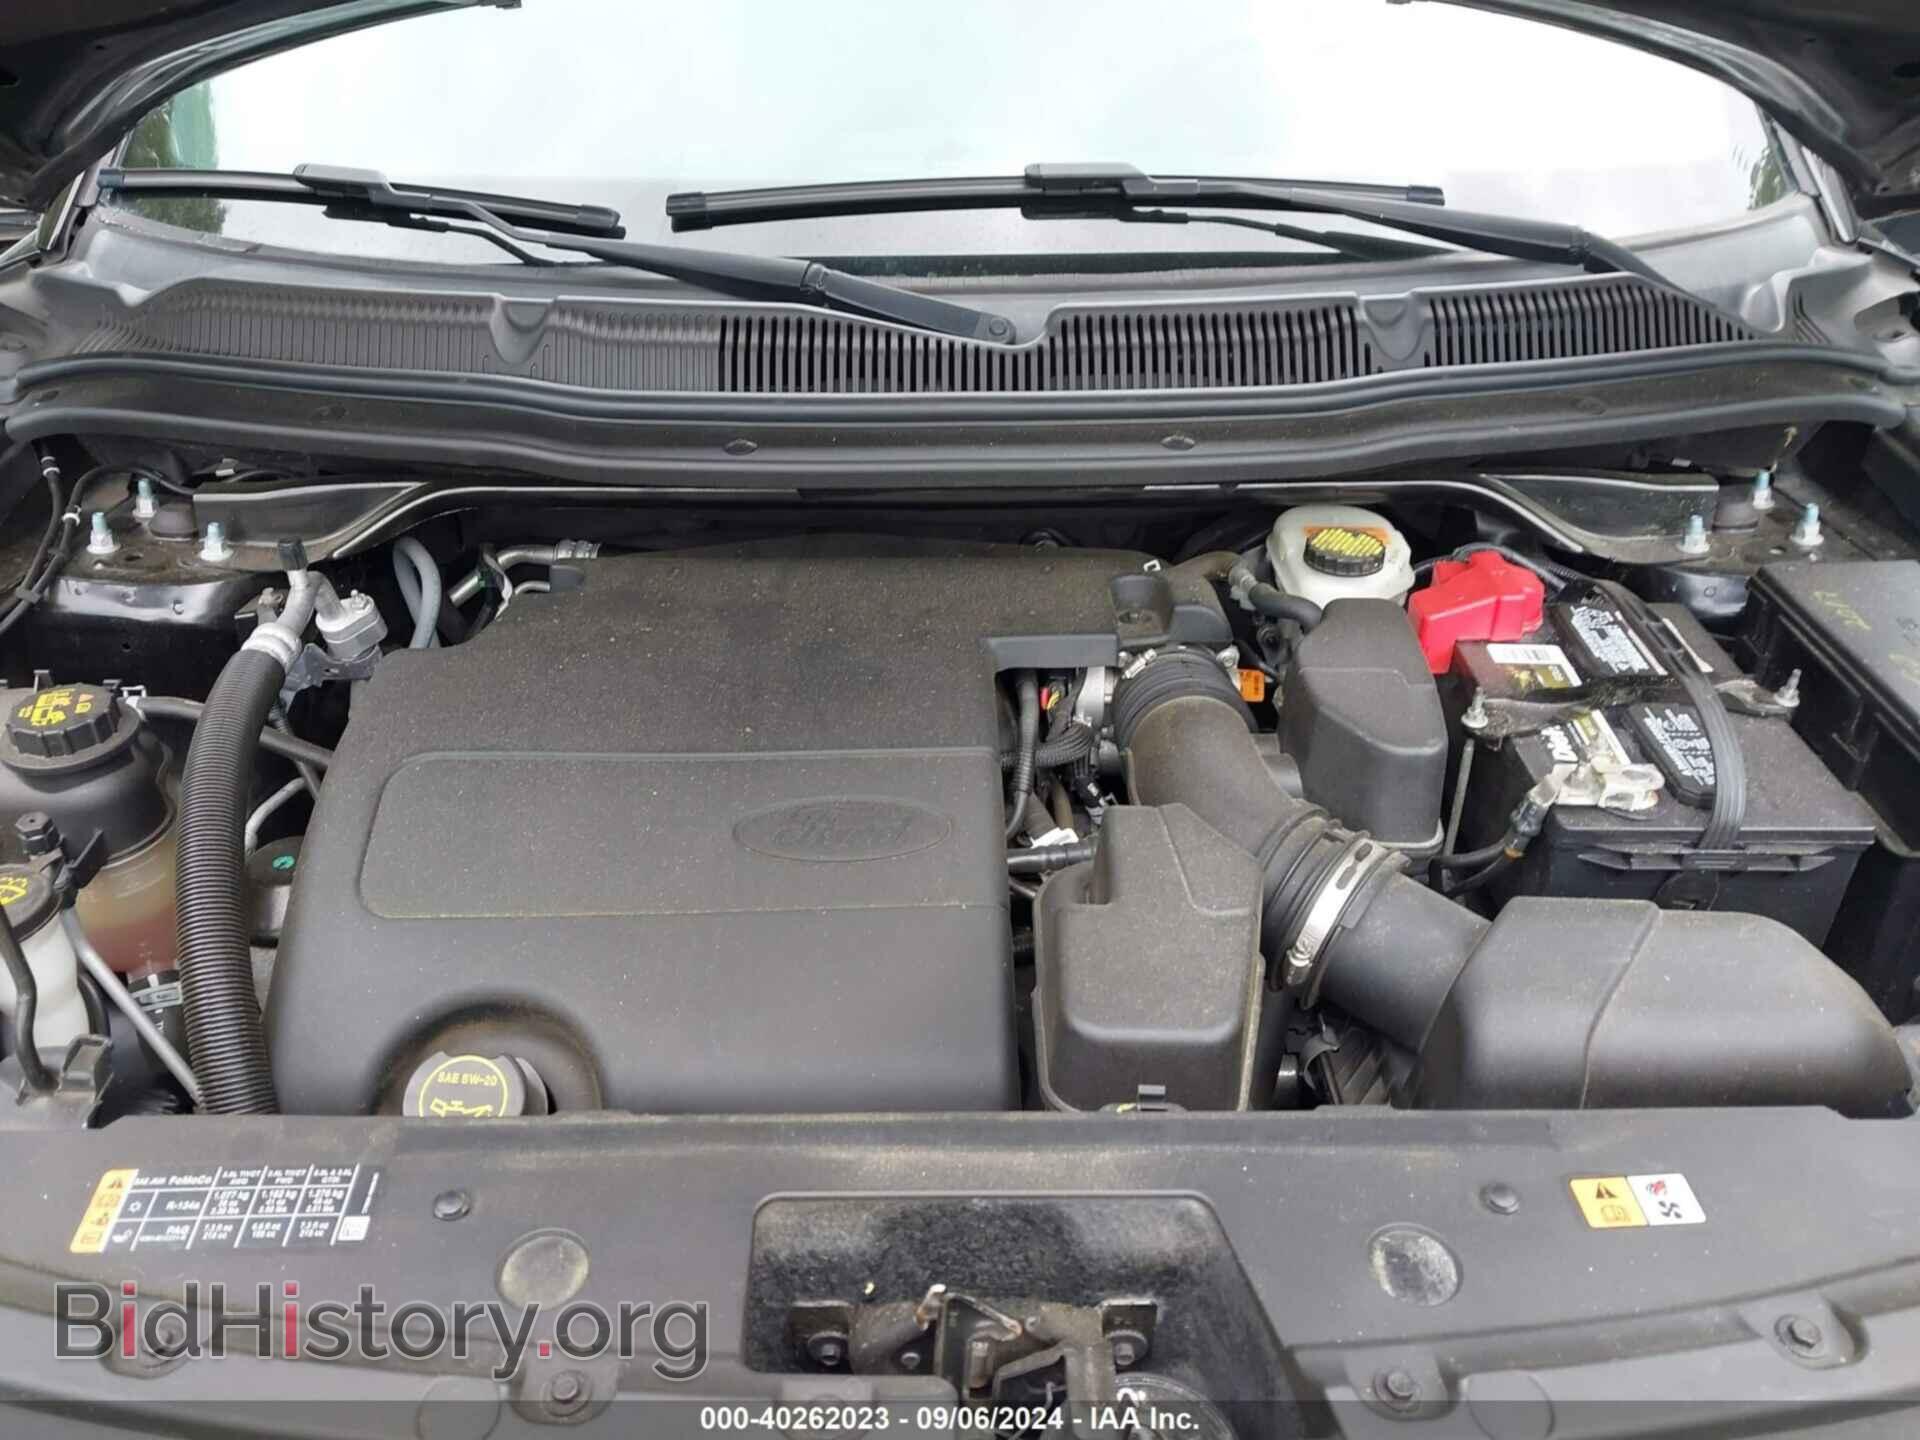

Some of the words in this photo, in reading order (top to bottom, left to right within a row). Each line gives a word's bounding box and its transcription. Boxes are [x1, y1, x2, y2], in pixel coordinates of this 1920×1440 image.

[438, 1072, 459, 1084] SAE
[461, 1073, 497, 1086] 5W-20
[166, 1201, 200, 1210] R-134a
